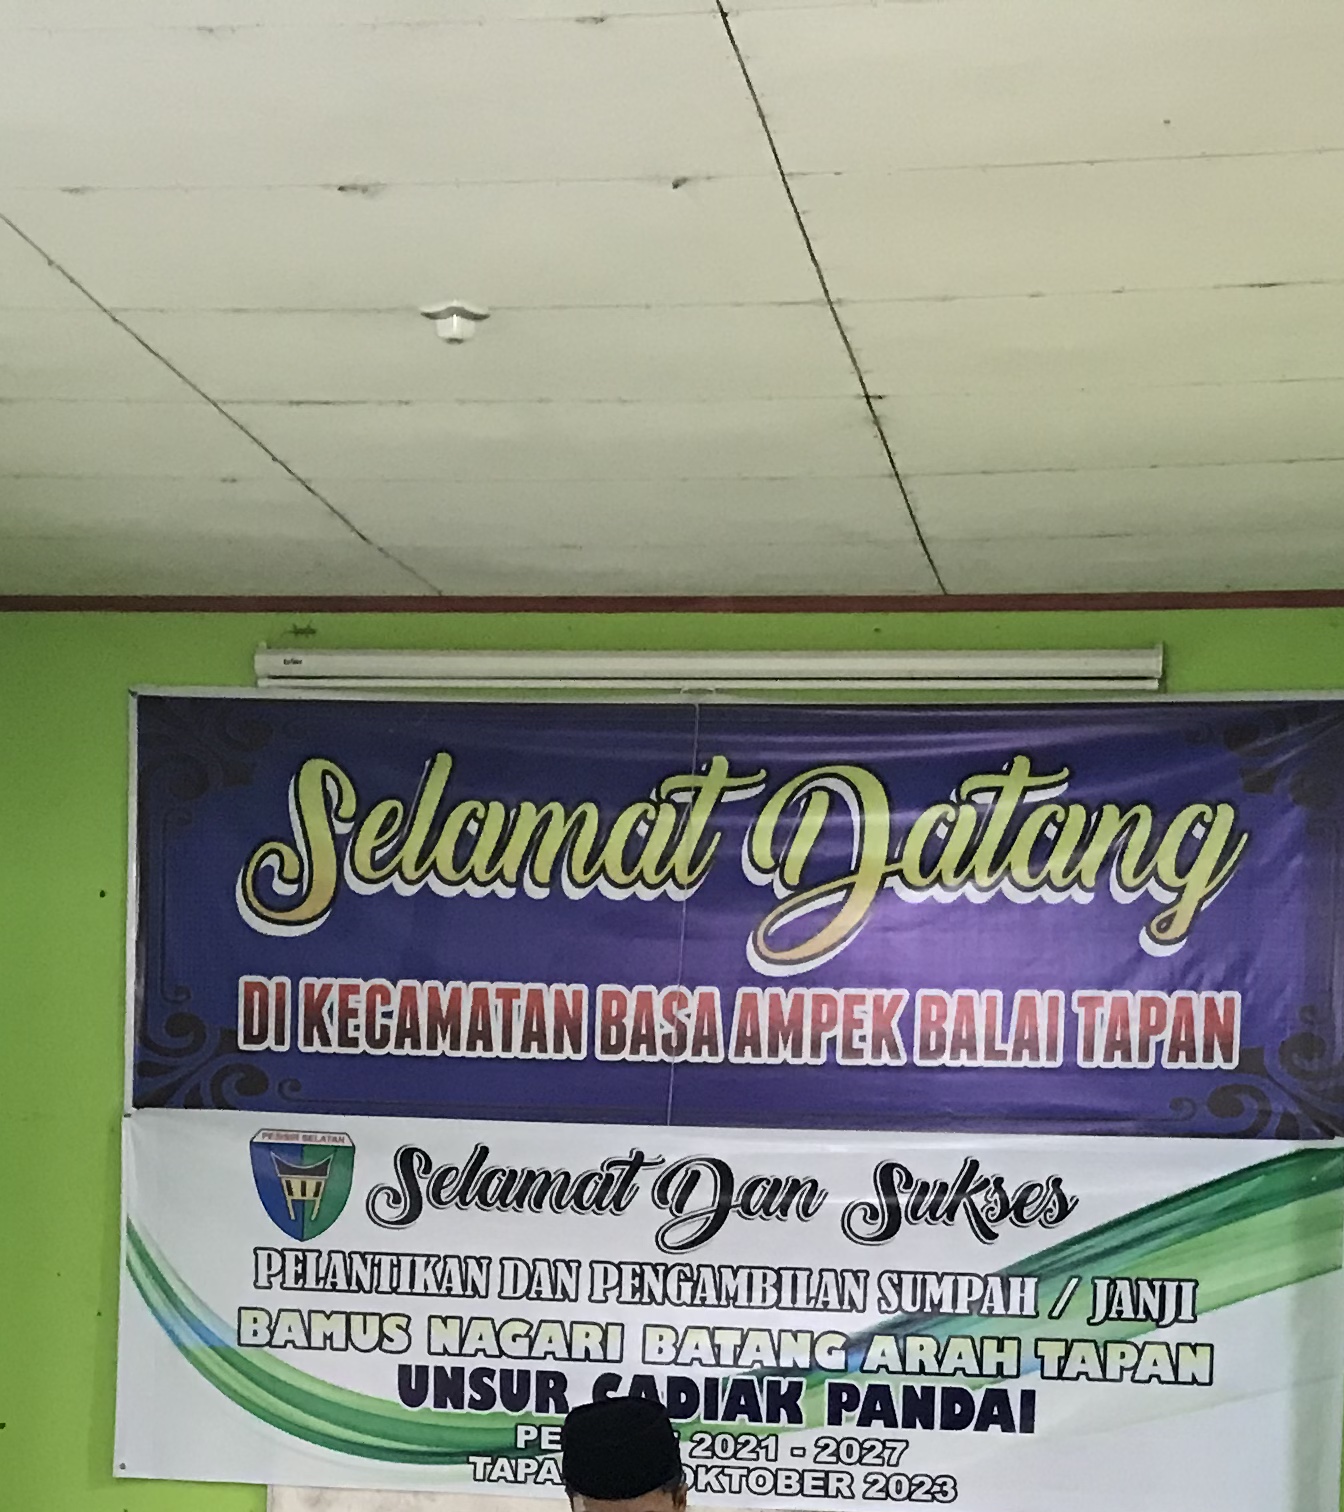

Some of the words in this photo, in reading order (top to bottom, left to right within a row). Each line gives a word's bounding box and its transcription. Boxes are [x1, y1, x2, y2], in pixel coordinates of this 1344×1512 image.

[236, 752, 766, 936] Selamat
[741, 755, 1248, 977] Datang
[238, 976, 291, 1051] DI
[298, 977, 588, 1060] KECAMATAN
[595, 984, 723, 1063] BASA
[729, 986, 909, 1066] AMPEK
[913, 989, 1065, 1067] BALAI
[1071, 989, 1241, 1069] TAPAN
[366, 1143, 664, 1229] Selamat
[650, 1153, 827, 1254] Dan
[841, 1156, 1079, 1245] Sukses
[254, 1248, 491, 1298] PELANTIKAN
[499, 1257, 580, 1302] DAN
[590, 1261, 869, 1312] PENGAMBILAN
[878, 1270, 1038, 1318] SUMPAH
[1048, 1277, 1081, 1318] /
[1088, 1277, 1198, 1327] JANJI
[237, 1307, 412, 1354] BAMUS
[427, 1315, 624, 1362] NAGARI
[642, 1324, 848, 1371] BATANG
[862, 1334, 1021, 1378] ARAH
[1034, 1338, 1213, 1386] TAPAN
[398, 1365, 568, 1414] UNSUR
[826, 1383, 1035, 1433] PANDAI
[469, 1456, 564, 1485] TAPA
[862, 1473, 958, 1503] 2023
[689, 1431, 778, 1461] 2021
[790, 1446, 806, 1457] -
[814, 1437, 909, 1466] 2027
